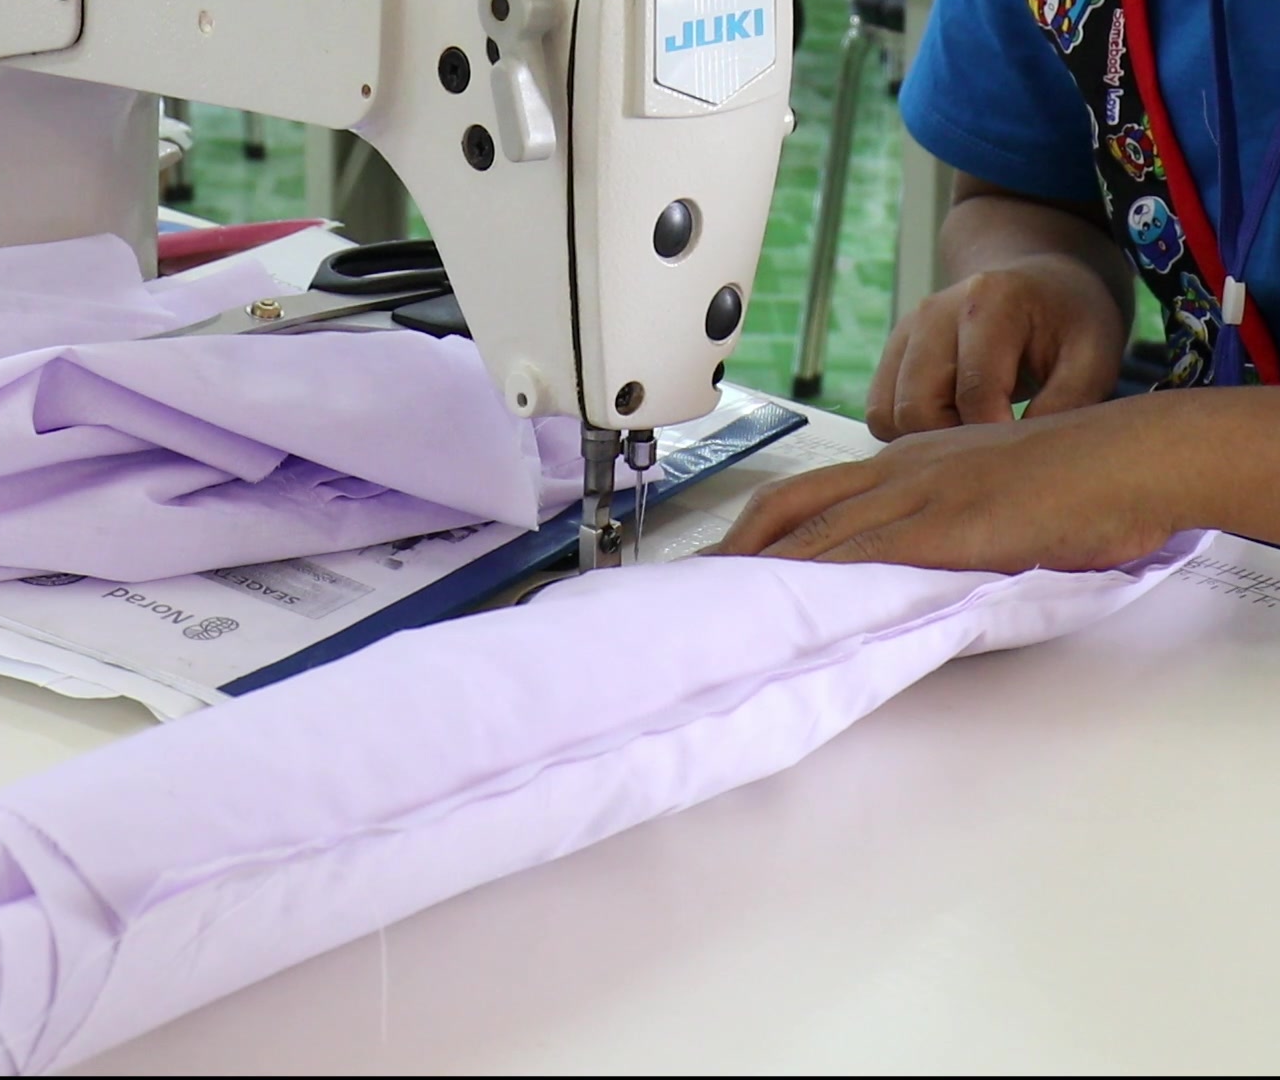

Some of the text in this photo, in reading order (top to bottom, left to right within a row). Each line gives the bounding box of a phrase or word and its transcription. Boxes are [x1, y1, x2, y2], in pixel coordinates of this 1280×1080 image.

[665, 8, 764, 53] JUKI
[1103, 8, 1126, 86] Somebody
[101, 587, 195, 625] Norad
